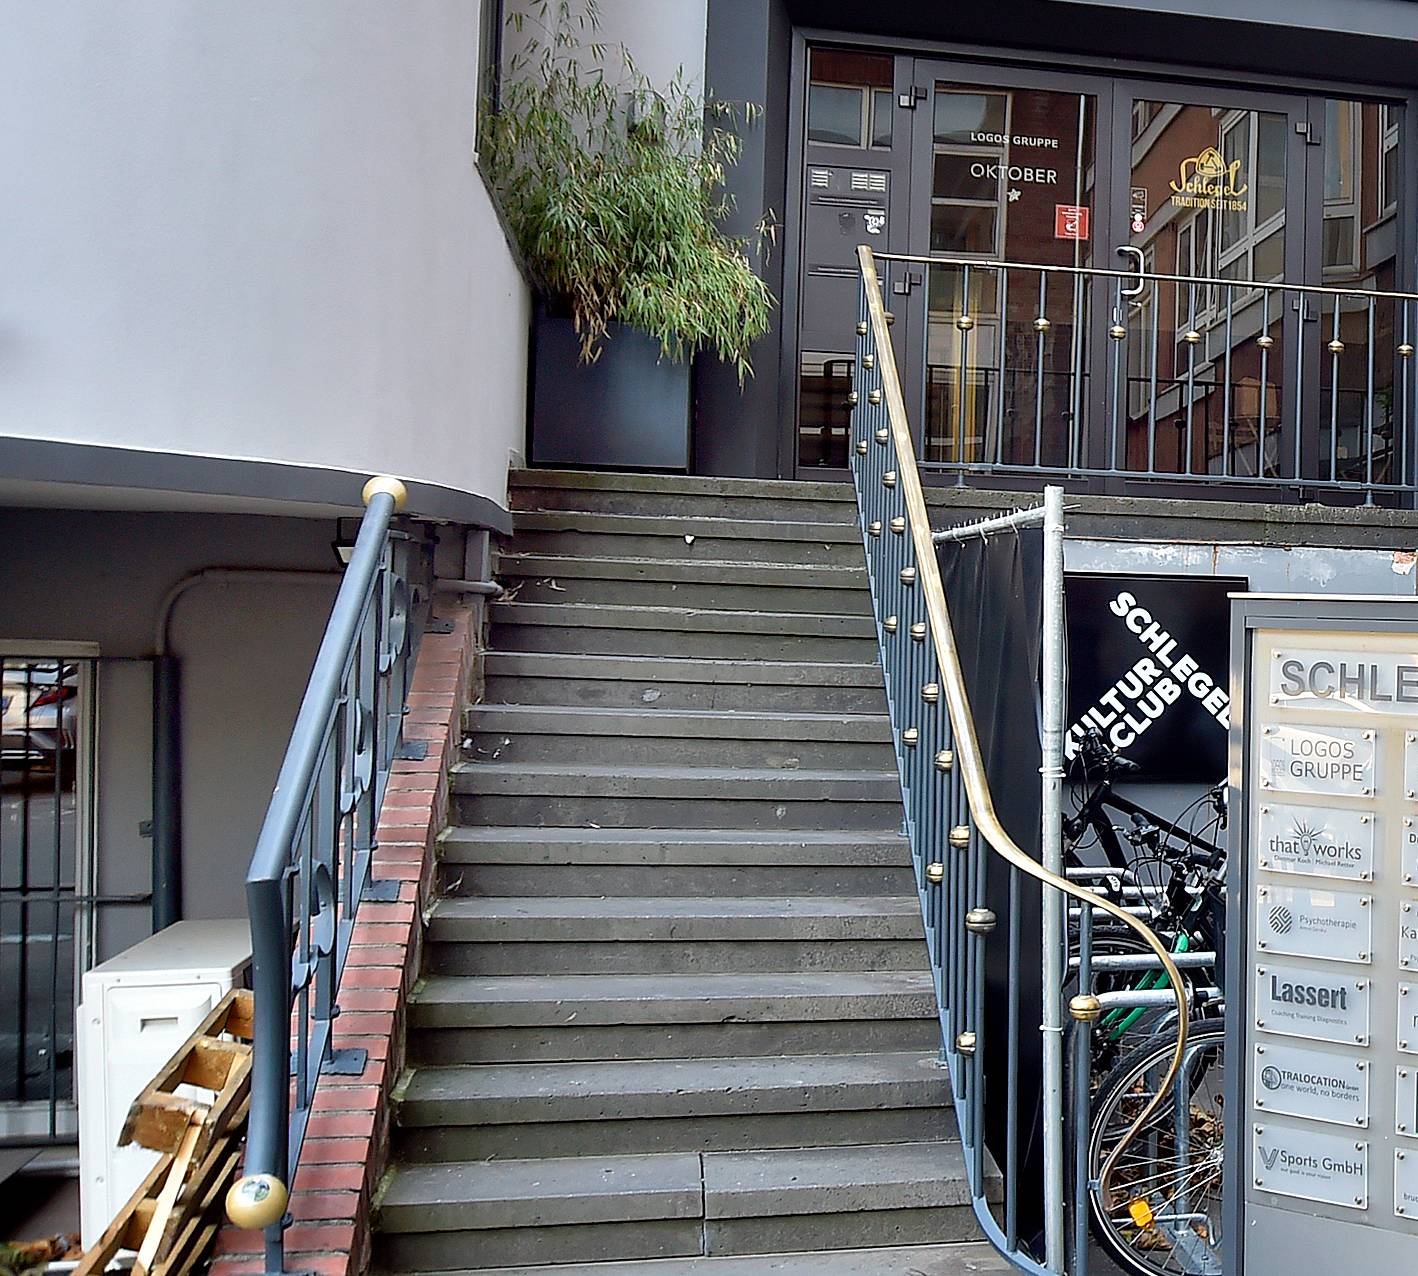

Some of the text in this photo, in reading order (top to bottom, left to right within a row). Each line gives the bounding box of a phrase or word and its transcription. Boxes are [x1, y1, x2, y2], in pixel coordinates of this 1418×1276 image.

[970, 132, 1059, 148] LOGOS GRUPPE
[970, 163, 1057, 184] OKTOBER
[1169, 157, 1248, 197] Schlegel
[1171, 195, 1248, 211] TRADITION SEIT 1854
[1109, 592, 1230, 730] SCHLEGEL
[1291, 739, 1354, 759] LOGOS
[1290, 760, 1363, 781] GRUPPE
[1270, 835, 1300, 854] that
[1313, 842, 1361, 860] works
[1299, 914, 1357, 929] Psychotherapie
[1271, 975, 1347, 1010] Lassert
[1271, 1009, 1295, 1019] Coaching
[1296, 1011, 1316, 1022] Training
[1281, 1070, 1346, 1090] TRALOCATION
[1281, 1083, 1360, 1102] one world, no borders
[1280, 1150, 1318, 1168] Sports
[1322, 1158, 1363, 1176] GmbH
